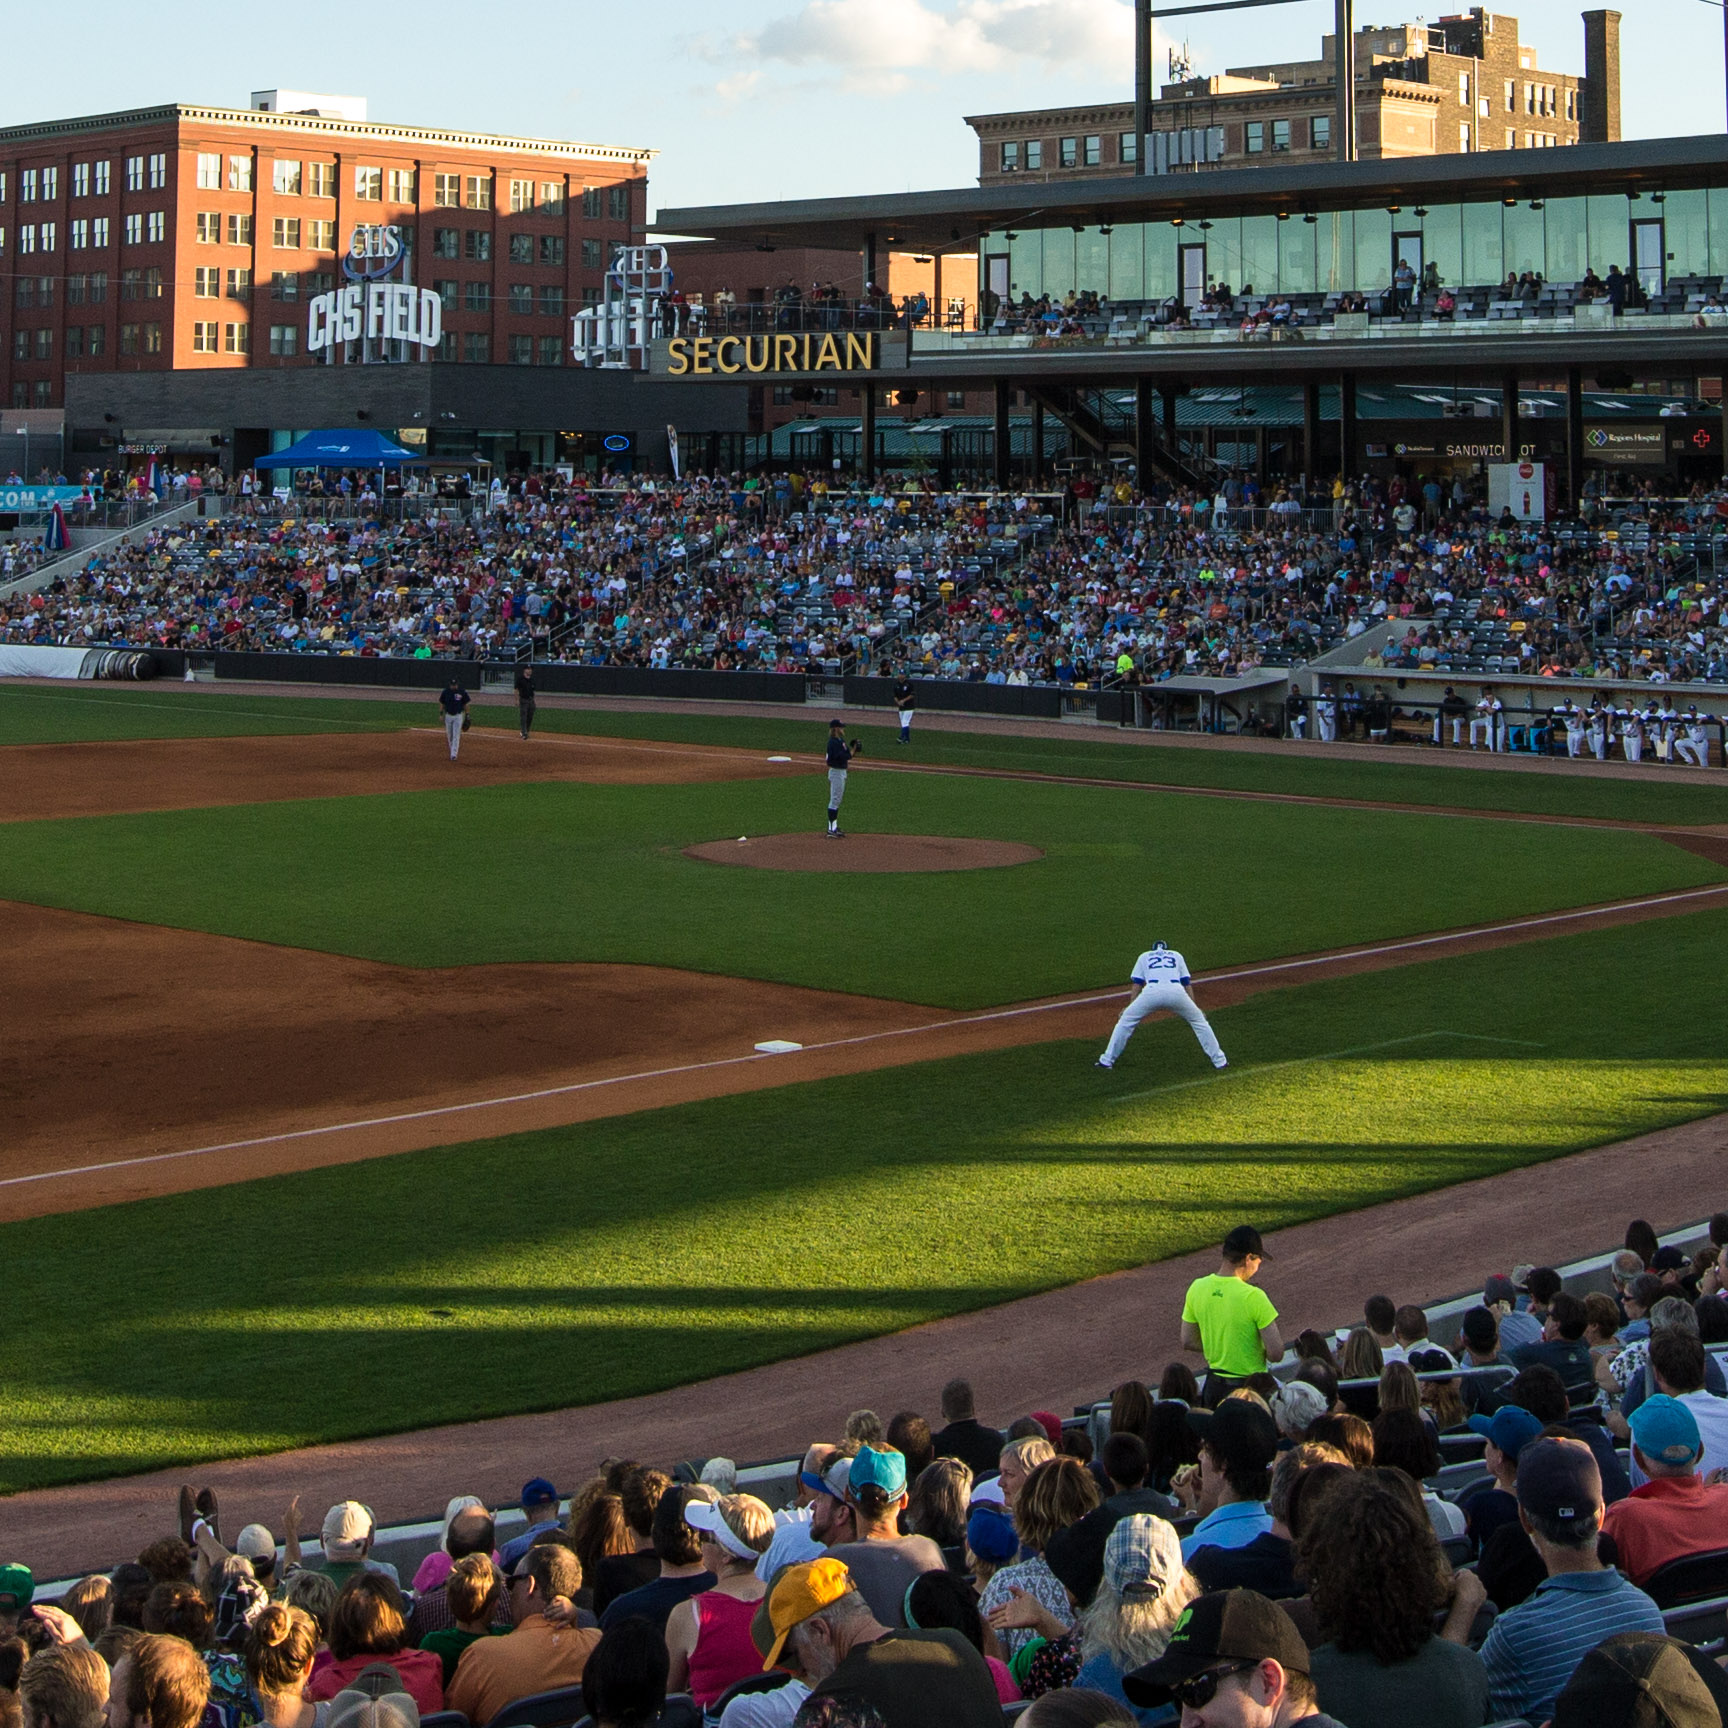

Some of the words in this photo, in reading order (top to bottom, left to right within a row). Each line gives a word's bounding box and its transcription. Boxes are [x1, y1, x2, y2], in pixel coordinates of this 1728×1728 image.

[350, 225, 398, 259] CHS
[308, 285, 363, 351] CHS
[368, 283, 441, 347] FIELD
[667, 331, 872, 375] SECURIAN
[1148, 955, 1177, 969] 23
